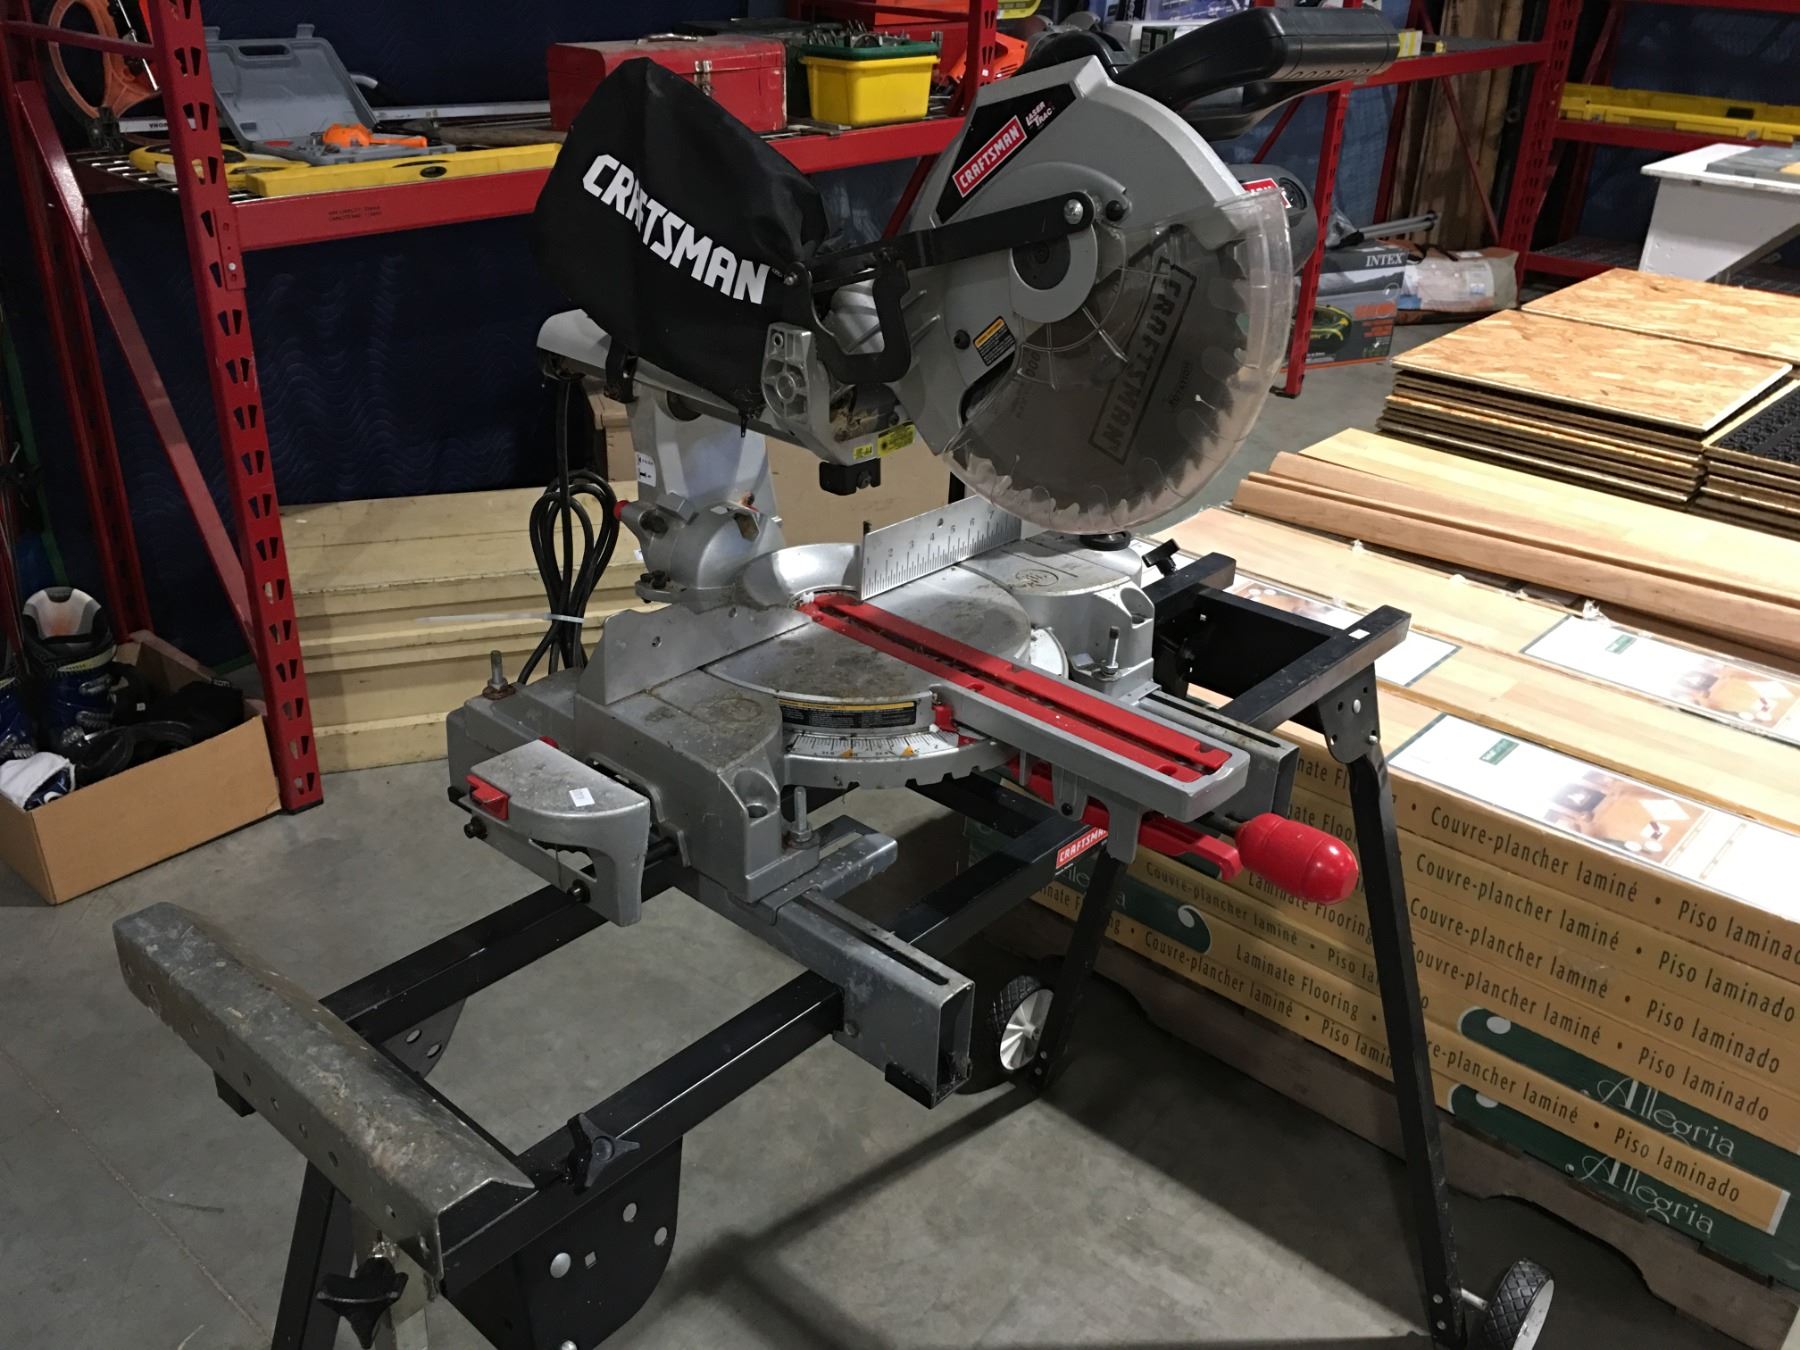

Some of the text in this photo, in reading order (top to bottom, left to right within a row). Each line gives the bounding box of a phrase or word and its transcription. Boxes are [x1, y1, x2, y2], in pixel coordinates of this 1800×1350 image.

[958, 125, 1021, 188] CRAFTSMAN
[1025, 101, 1046, 127] LASER
[1365, 252, 1405, 268] INTEX
[1103, 276, 1182, 450] CRAFTSMAN
[1146, 862, 1248, 919] Couvre-plancher
[1254, 913, 1298, 946] laminé
[1327, 947, 1356, 975] Piso
[1416, 853, 1553, 923] Couvre-plancher
[1559, 909, 1620, 951] laminé
[1658, 950, 1698, 983] Piso
[1705, 968, 1796, 1022] laminado
[1431, 806, 1568, 876] Couvre-plancher
[1577, 861, 1638, 903] laminé
[1678, 900, 1718, 932] Piso
[1725, 916, 1800, 965] lamina
[1144, 931, 1245, 994] Couvre-plancher
[1249, 982, 1294, 1019] laminé
[1321, 1018, 1350, 1047] Piso
[1355, 1035, 1393, 1070] lamin
[1315, 902, 1373, 945] Flooring
[1413, 942, 1537, 1015] ouvre-plancher
[1543, 1003, 1602, 1046] laminé
[1637, 1046, 1676, 1079] Piso
[1682, 1066, 1769, 1122] laminado
[1410, 898, 1780, 1073] Couvre-plancher laminé Piso laminado
[1236, 943, 1296, 987] Laminate
[1301, 976, 1359, 1021] Flooring
[1522, 1081, 1579, 1125] laminé
[1614, 1126, 1650, 1158] Piso
[1657, 1146, 1740, 1202] laminado
[1580, 1076, 1736, 1159] Allegria
[1564, 1154, 1716, 1236] Allegria
